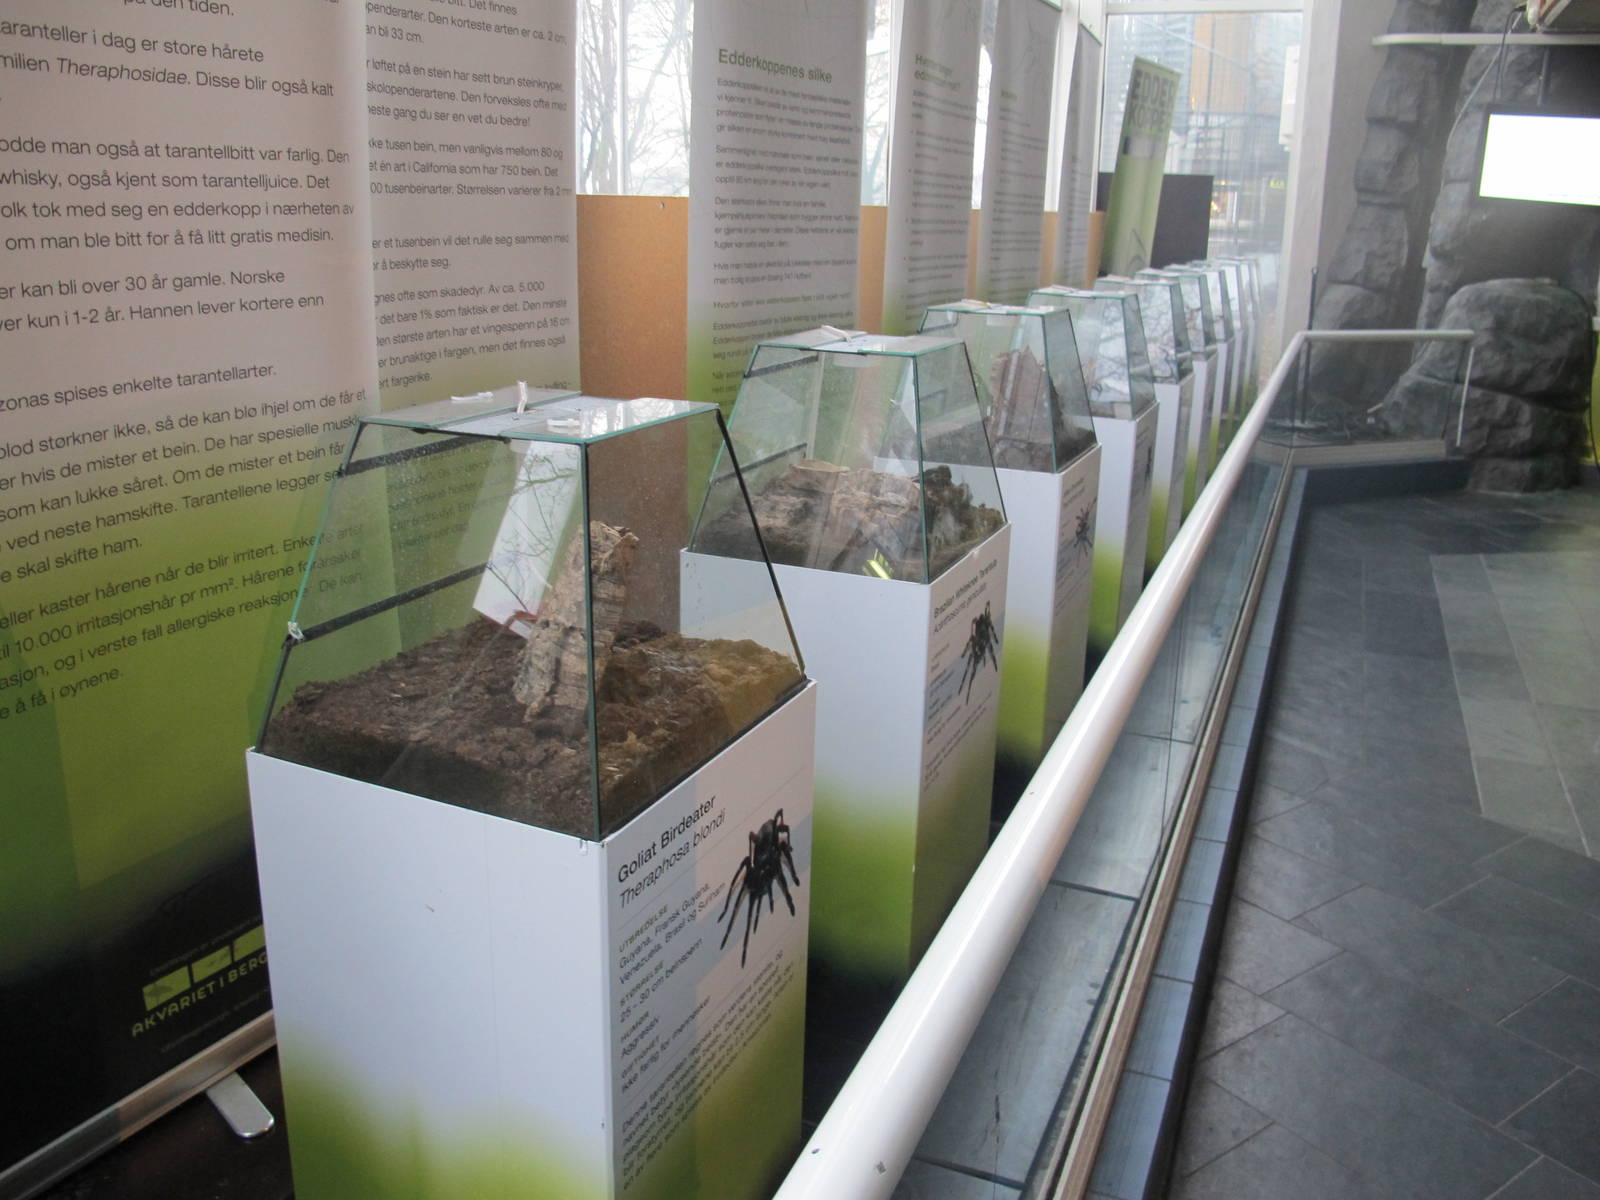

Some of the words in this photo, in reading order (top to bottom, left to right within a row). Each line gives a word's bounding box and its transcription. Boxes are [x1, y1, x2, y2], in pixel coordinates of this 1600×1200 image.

[102, 32, 136, 53] dag
[164, 40, 207, 57] store
[212, 43, 264, 62] hårete
[718, 48, 804, 79] Edderkoppenes
[808, 68, 832, 84] silke
[56, 58, 191, 85] Theraphosidae.
[196, 71, 240, 88] Disse
[244, 75, 267, 90] blir
[272, 79, 309, 96] også
[312, 81, 334, 96] kalt
[52, 141, 91, 155] man
[96, 142, 140, 160] også
[164, 144, 255, 160] tarantellbitt
[258, 150, 283, 160] var
[286, 147, 323, 166] farlig.
[412, 163, 457, 174] California
[500, 165, 519, 176] 750
[67, 172, 112, 190] også
[116, 172, 157, 190] kjent
[162, 176, 198, 187] som
[202, 174, 302, 192] tarantelljuice.
[306, 175, 330, 188] Det
[32, 203, 62, 218] tok
[66, 202, 106, 217] med
[111, 205, 143, 220] seg
[173, 202, 261, 218] edderkopp
[273, 202, 340, 215] nærheten
[40, 236, 80, 249] man
[84, 233, 110, 248] ble
[115, 232, 142, 247] bitt
[146, 231, 170, 246] for
[208, 230, 226, 244] litt
[230, 229, 273, 247] gratis
[277, 228, 333, 242] medisin.
[21, 283, 53, 298] kan
[58, 280, 77, 296] bli
[82, 280, 120, 294] over
[125, 276, 147, 291] 30
[152, 275, 168, 290] år
[172, 272, 226, 292] gamle.
[230, 270, 285, 284] Norske
[27, 315, 60, 328] kun
[72, 309, 99, 324] 1-2
[105, 308, 124, 322] år.
[129, 304, 193, 320] Hannen
[197, 301, 236, 315] lever
[240, 297, 294, 312] kortere
[298, 296, 324, 308] enn
[54, 386, 108, 406] spises
[112, 376, 172, 395] enkelte
[176, 365, 276, 387] tarantellarter.
[113, 424, 151, 438] ikke,
[202, 411, 230, 424] kan
[262, 400, 289, 418] ihjel
[339, 390, 354, 404] får
[21, 468, 56, 486] hvis
[86, 453, 137, 472] mister
[230, 434, 254, 447] har
[258, 423, 319, 444] spesielle
[40, 496, 71, 512] kan
[75, 486, 118, 504] lukke
[123, 476, 168, 494] såret.
[228, 456, 274, 473] mister
[296, 447, 326, 462] bein
[329, 442, 345, 456] får
[6, 530, 40, 550] ved
[44, 521, 91, 541] neste
[96, 502, 177, 528] hamskifte.
[181, 483, 272, 508] Tarantellene
[276, 474, 320, 492] legger
[17, 557, 50, 579] skal
[55, 548, 98, 568] skifte
[103, 538, 142, 556] ham.
[39, 592, 90, 617] kaster
[95, 576, 151, 600] hårene
[155, 567, 180, 584] når
[208, 555, 229, 570] blir
[233, 544, 278, 564] irritert.
[15, 625, 72, 653] 10.000
[77, 595, 176, 634] irritasjonshår
[242, 566, 294, 587] Hårene
[88, 635, 138, 658] verste
[142, 625, 163, 642] fall
[166, 606, 235, 634] allergiske
[618, 843, 656, 883] Goliat
[661, 796, 715, 849] Birdeater
[620, 842, 690, 908] Theraphosa
[693, 808, 726, 847] blondi
[132, 981, 216, 1037] AKVARIET
